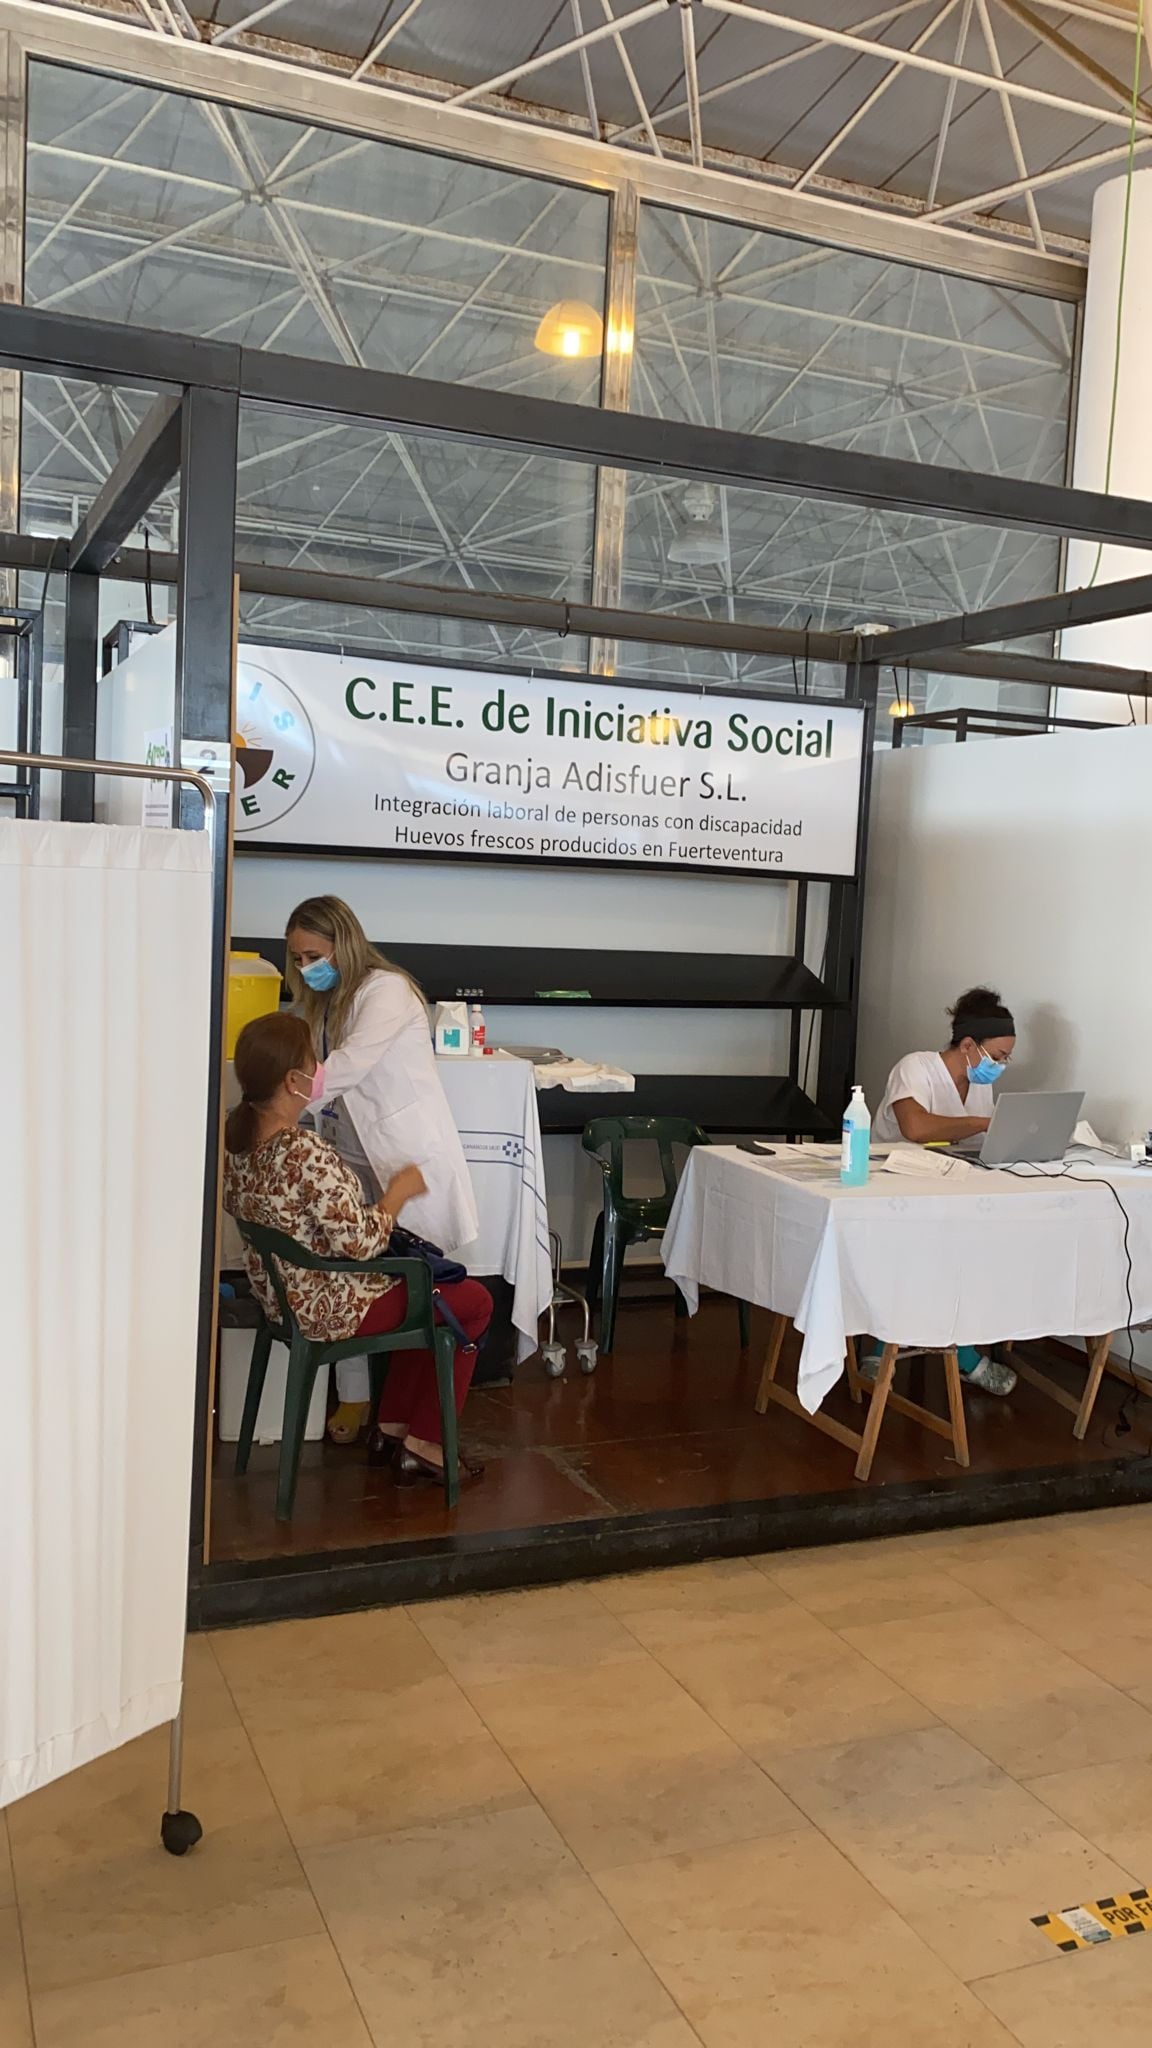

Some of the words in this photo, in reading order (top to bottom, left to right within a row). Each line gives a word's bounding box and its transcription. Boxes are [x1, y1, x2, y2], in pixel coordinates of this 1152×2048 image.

[345, 677, 464, 729] C.E.E.
[481, 689, 531, 734] de
[546, 697, 713, 749] Iniciativa
[727, 713, 834, 759] Social
[445, 752, 551, 796] Granja
[561, 761, 691, 798] Adisfuer
[699, 771, 747, 802] S.L.
[374, 793, 481, 818] Integración
[487, 800, 549, 822] laboral
[555, 805, 577, 824] de
[582, 809, 660, 829] personas
[664, 815, 695, 831] con
[699, 814, 804, 838] discapacidad
[395, 825, 465, 847] Huevos
[470, 829, 535, 850] frescos
[540, 836, 638, 856] producidos
[642, 843, 664, 858] en
[668, 841, 784, 864] Fuerteventura
[1102, 1906, 1141, 1926] POR
